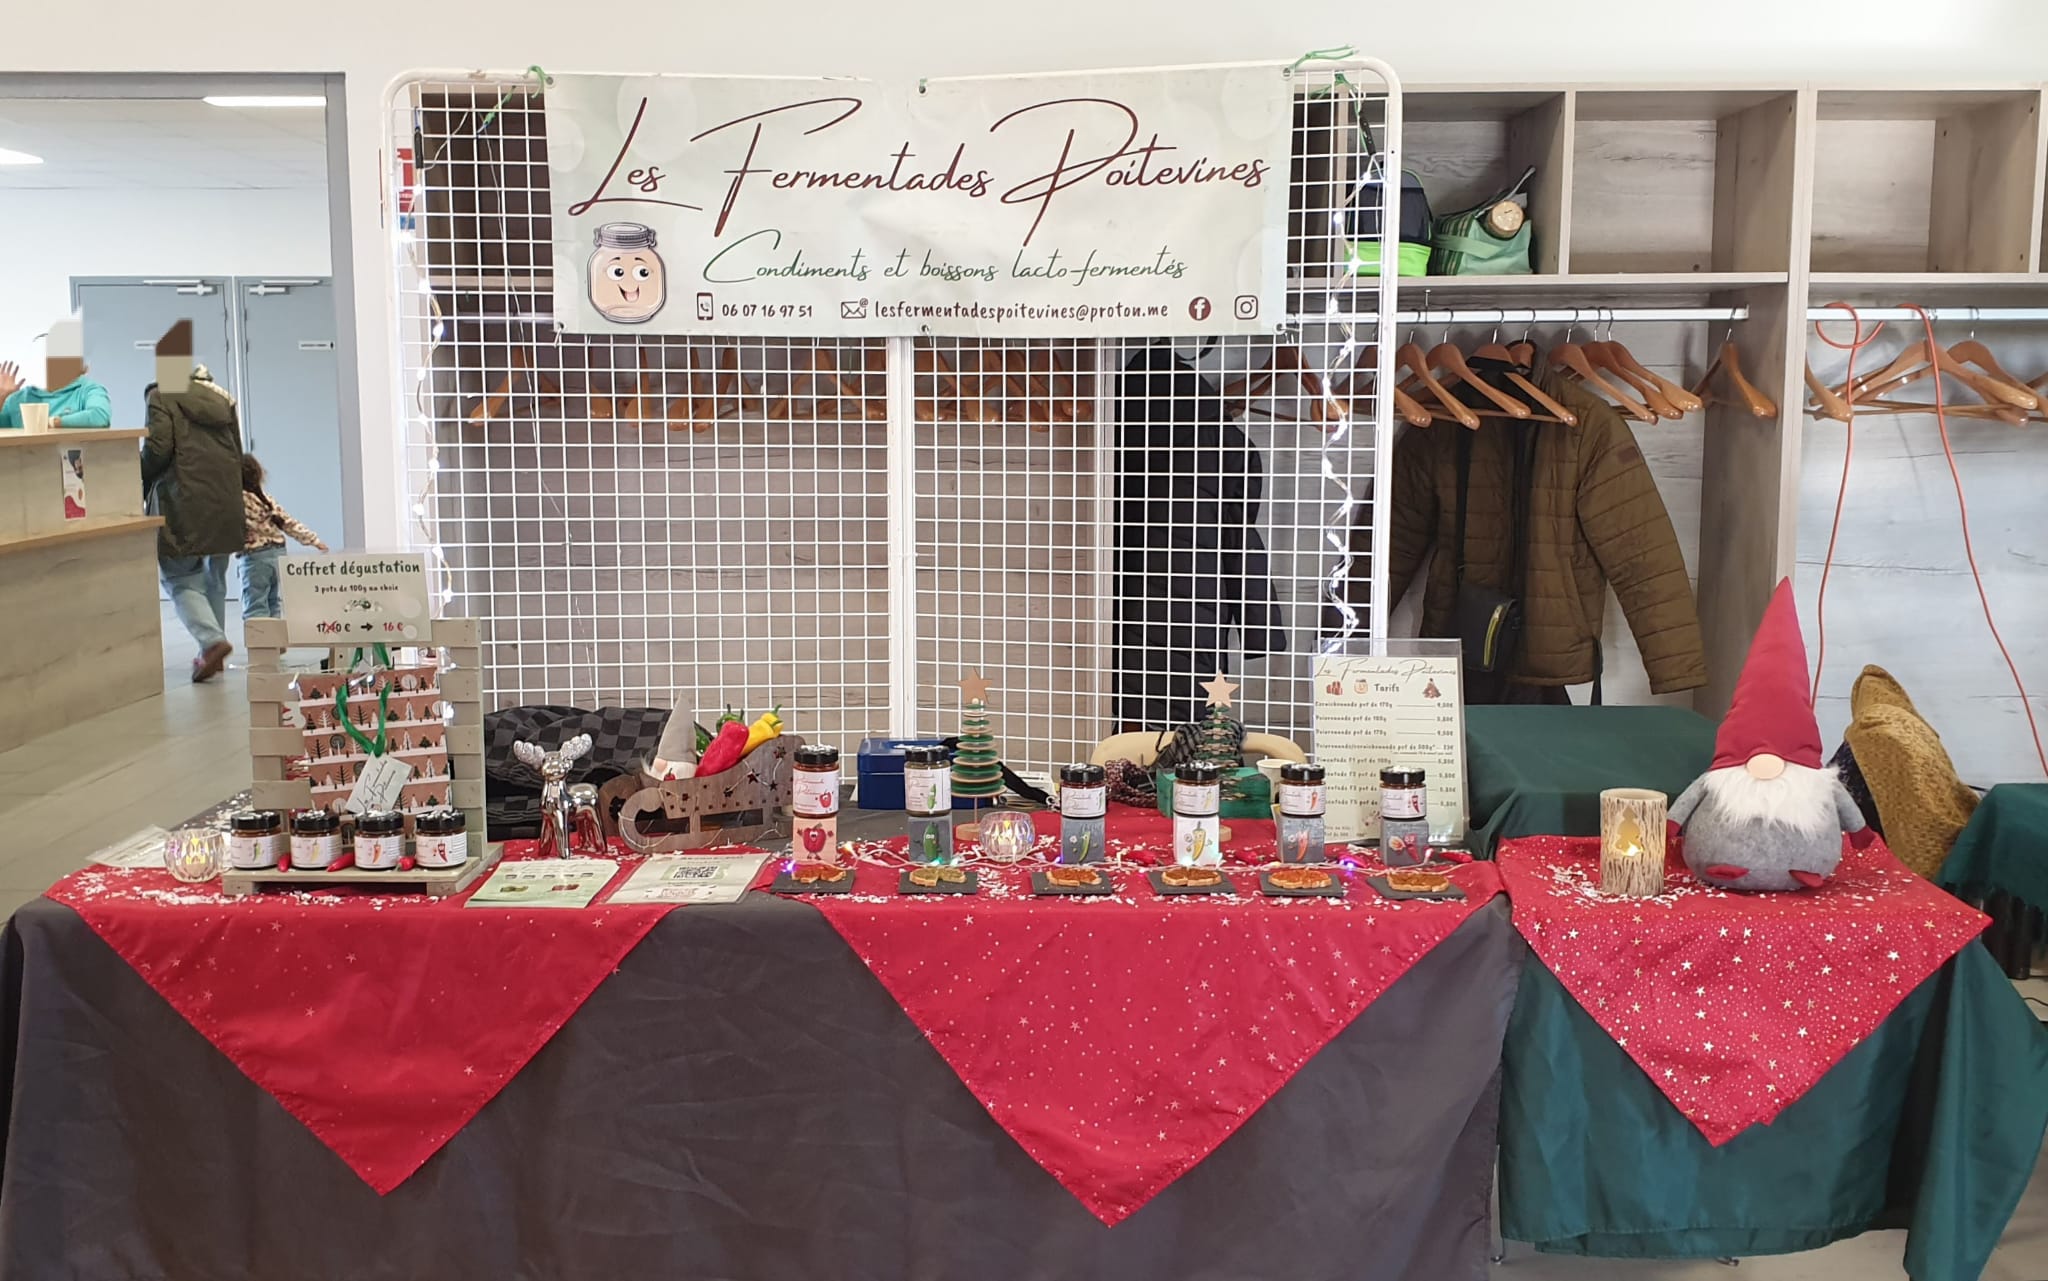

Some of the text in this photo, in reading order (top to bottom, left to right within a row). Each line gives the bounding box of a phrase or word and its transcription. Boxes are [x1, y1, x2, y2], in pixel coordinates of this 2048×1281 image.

[567, 96, 1271, 248] Les Fermentades Poitevines
[703, 229, 1188, 287] Condiments et boissons lacto-fermentés
[721, 304, 813, 318] 06 07 16 97 51
[875, 300, 1168, 322] lesfermentadespoitevines@proton.me
[286, 560, 420, 578] Coffret dégustation
[321, 585, 337, 595] pots
[339, 584, 347, 592] de
[349, 584, 367, 593] 100g
[344, 623, 351, 632] €
[383, 622, 394, 632] 16
[397, 622, 404, 631] €
[1374, 683, 1400, 693] Tarifs
